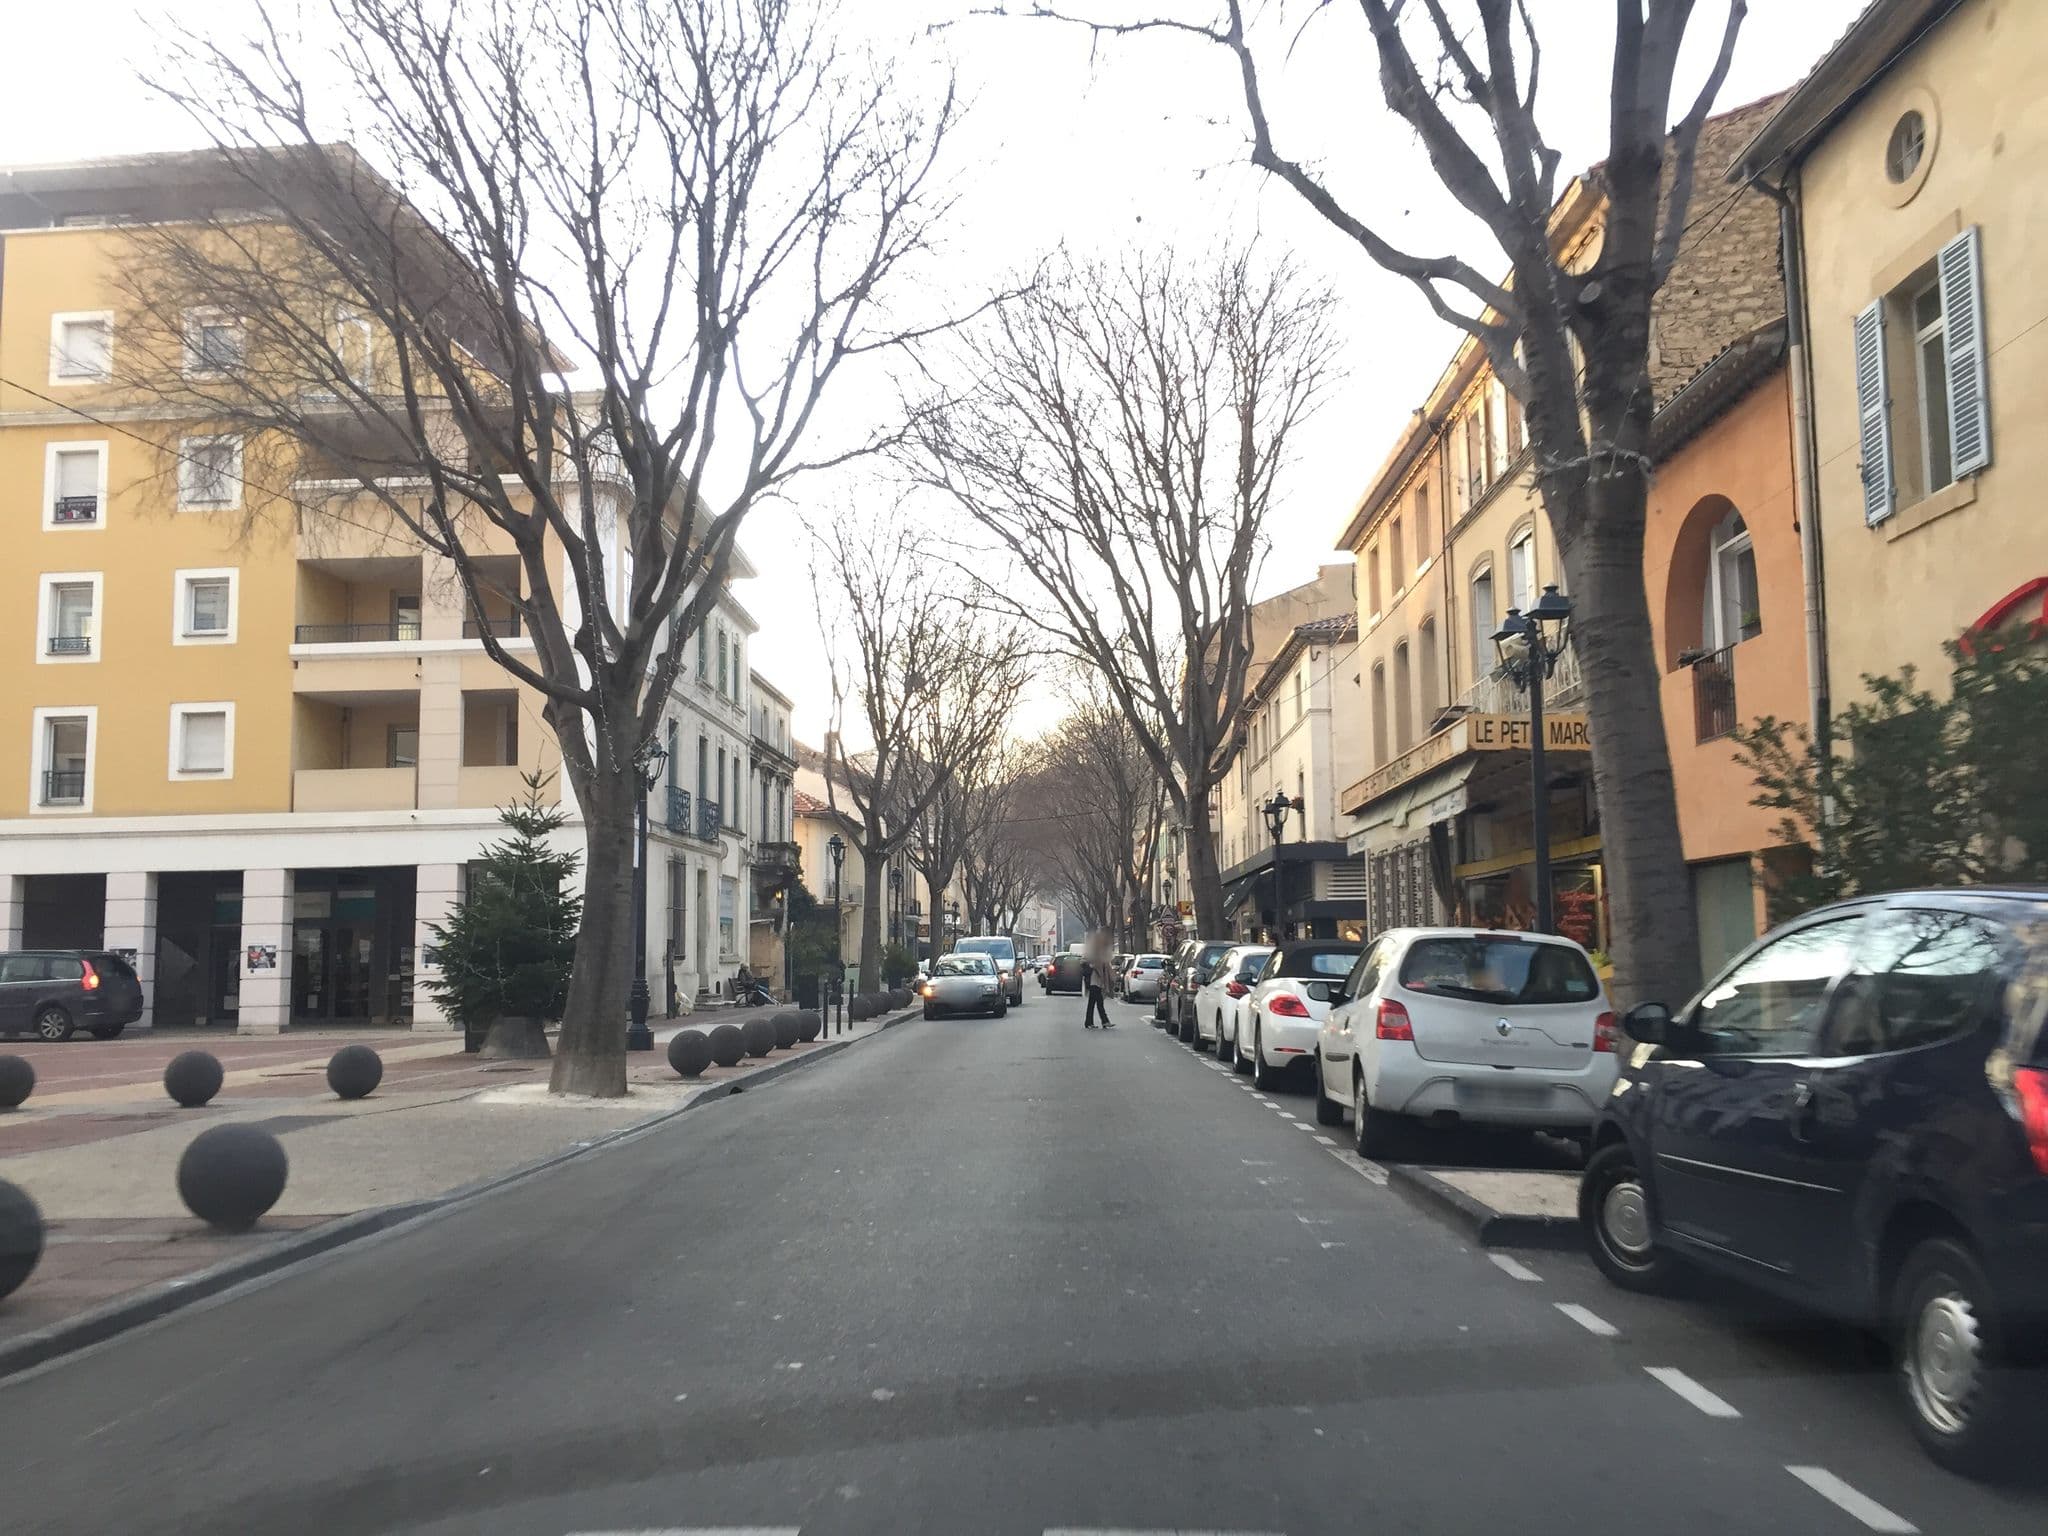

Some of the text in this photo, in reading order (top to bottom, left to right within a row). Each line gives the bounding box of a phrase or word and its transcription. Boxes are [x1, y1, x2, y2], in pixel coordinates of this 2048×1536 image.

[1475, 720, 1591, 745] LE PET MARC
